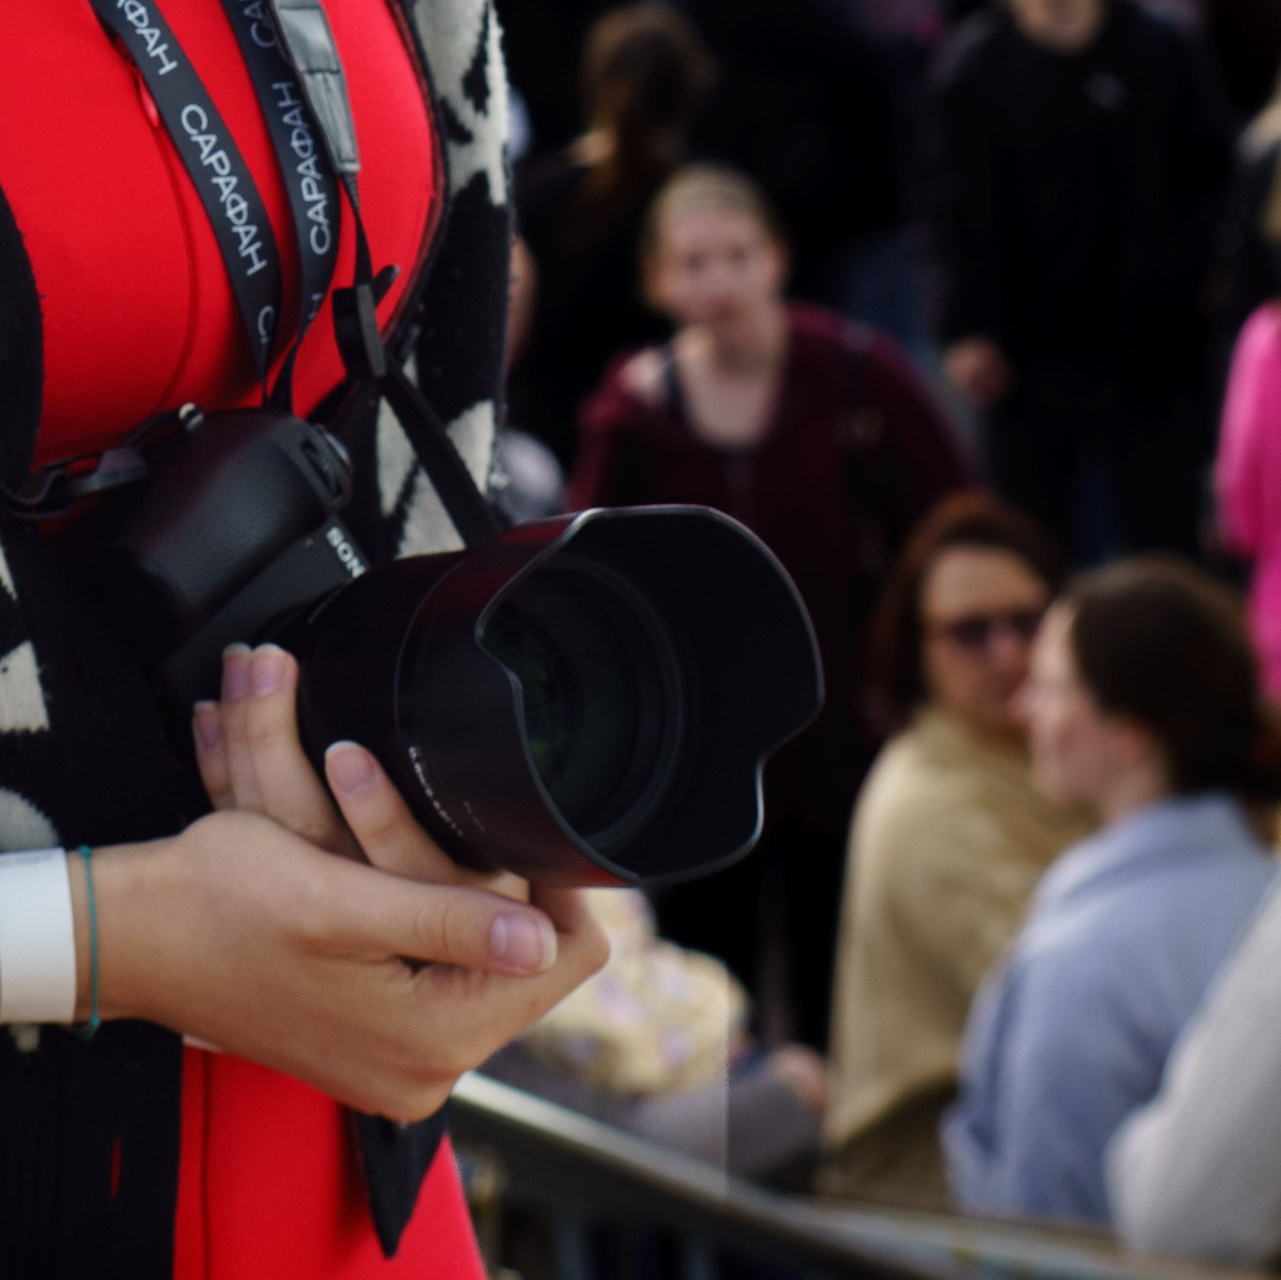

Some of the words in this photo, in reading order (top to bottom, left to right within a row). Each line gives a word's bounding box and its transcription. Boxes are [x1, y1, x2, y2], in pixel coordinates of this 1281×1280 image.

[180, 103, 267, 275] САРАФАН
[271, 81, 331, 255] САРАФАН
[326, 526, 366, 578] SON
